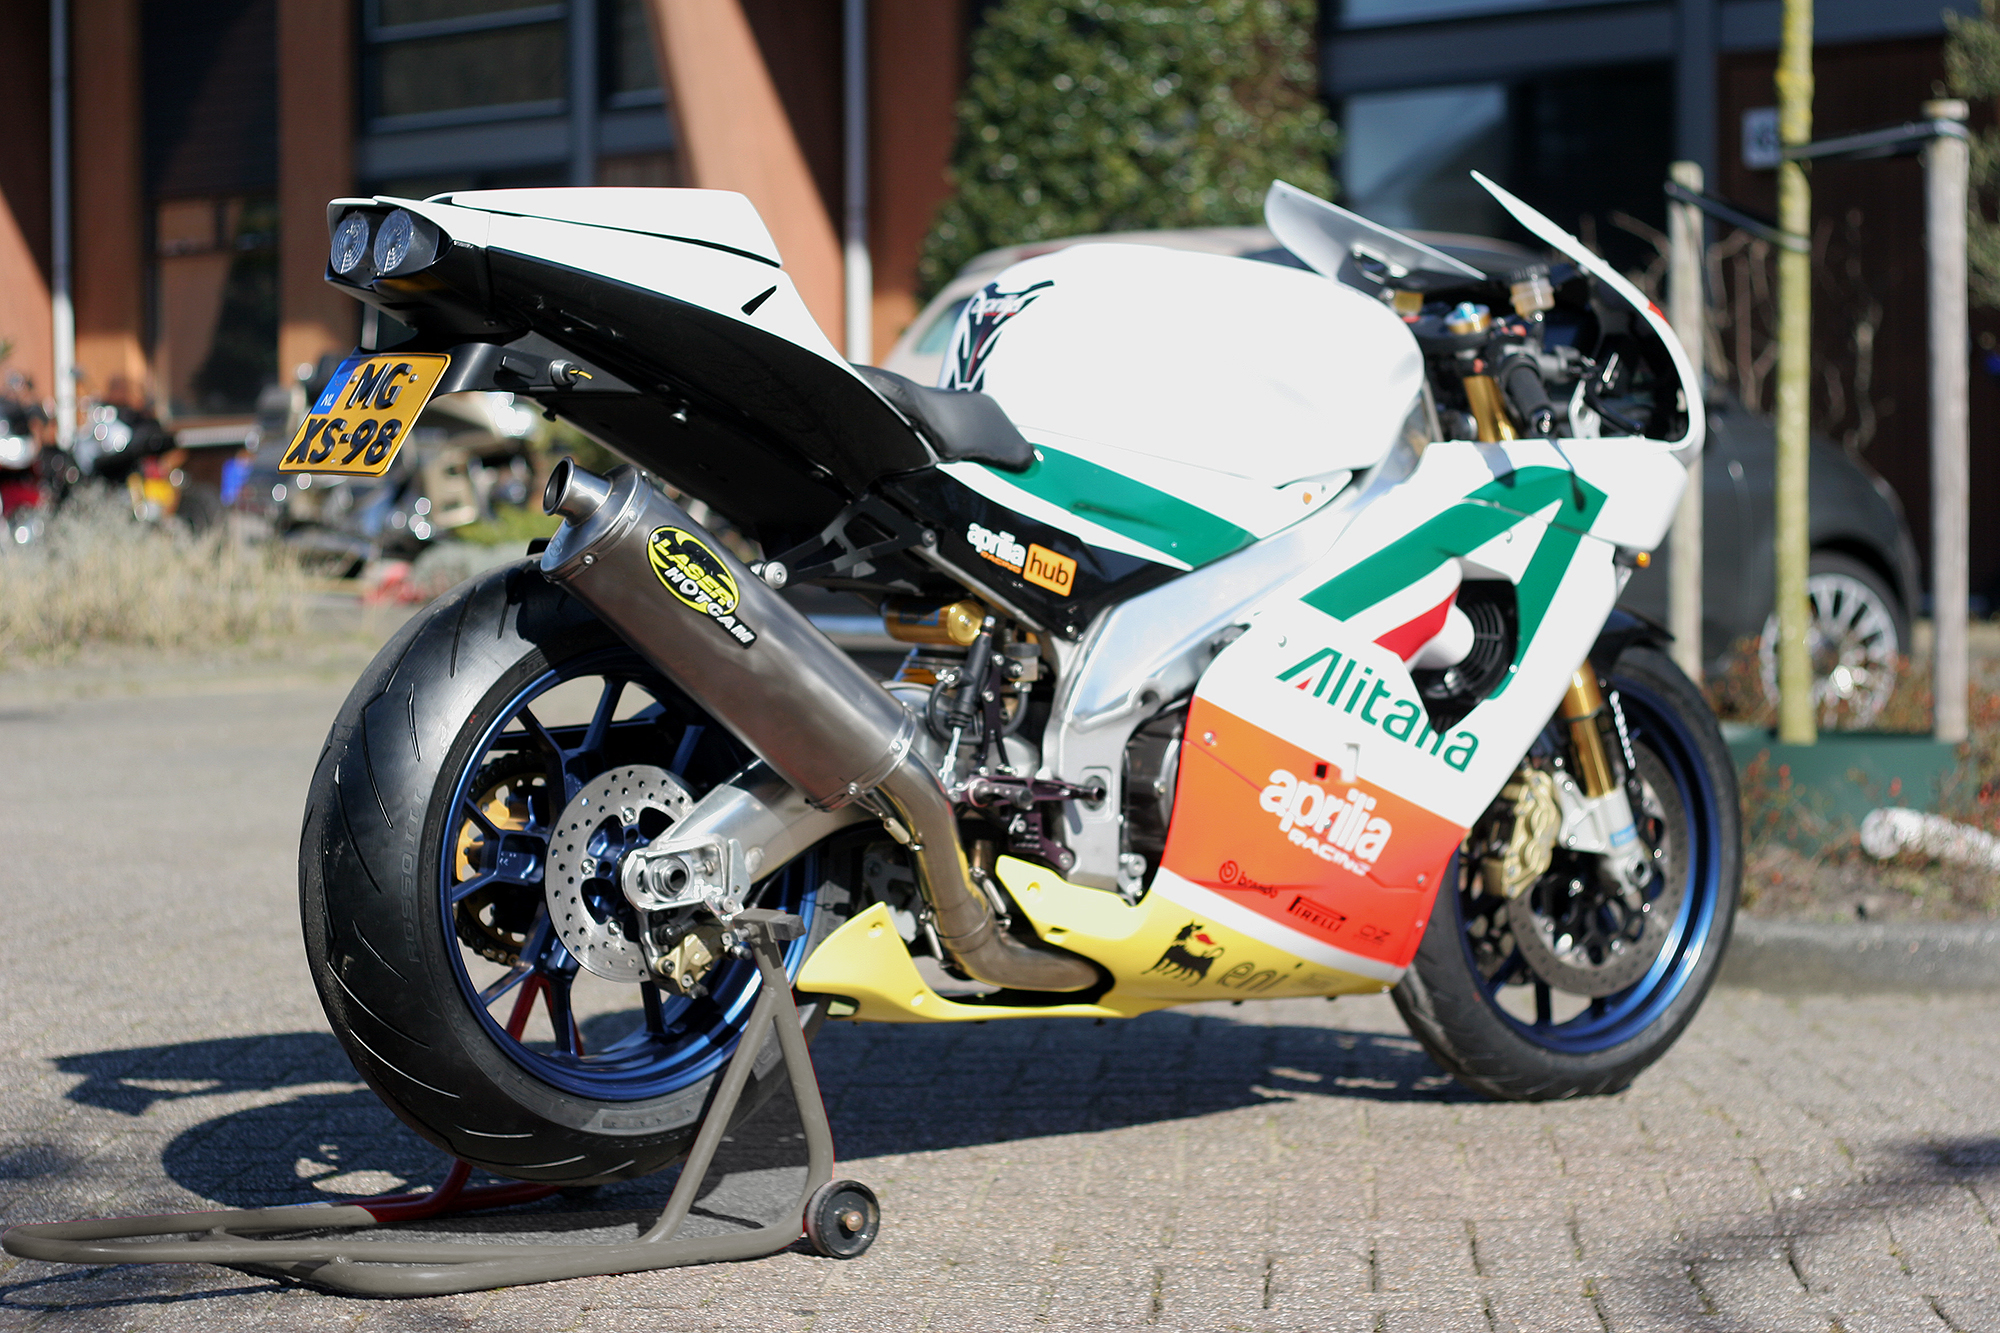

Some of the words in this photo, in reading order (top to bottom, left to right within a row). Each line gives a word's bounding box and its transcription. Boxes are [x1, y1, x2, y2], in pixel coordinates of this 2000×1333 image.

[320, 393, 335, 407] NL
[344, 363, 413, 410] MG
[285, 418, 402, 466] XS-98
[654, 538, 734, 606] LASER
[1029, 551, 1069, 586] hub
[1259, 769, 1392, 863] aprilia
[1287, 895, 1347, 932] PIRELLI
[1216, 962, 1303, 993] eni
